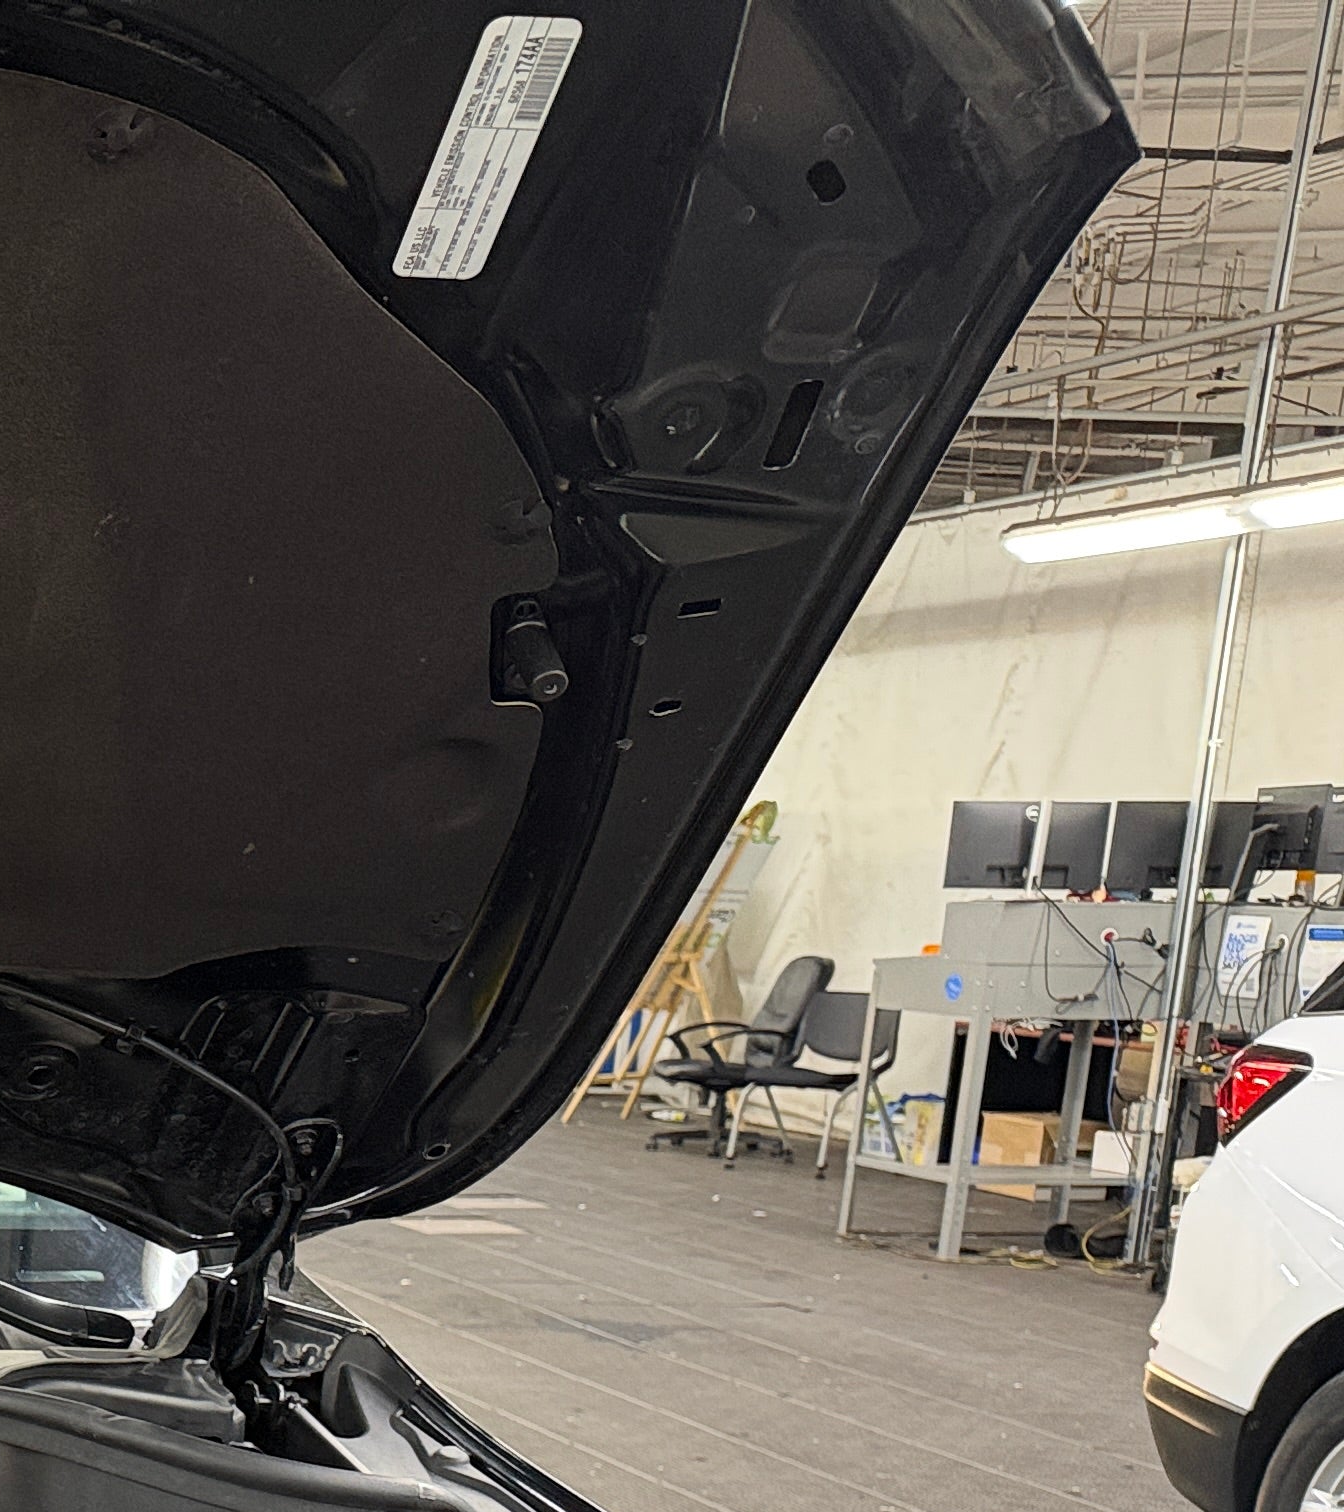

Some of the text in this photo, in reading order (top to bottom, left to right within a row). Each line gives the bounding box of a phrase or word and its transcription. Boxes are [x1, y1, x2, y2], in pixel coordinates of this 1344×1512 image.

[515, 35, 545, 74] 174AA
[431, 168, 452, 197] VEHICLE
[444, 129, 466, 165] EMISSION
[459, 93, 481, 127] CONTROL
[474, 34, 504, 90] INFORMATION
[403, 256, 416, 269] FCA
[414, 226, 428, 240] LLC
